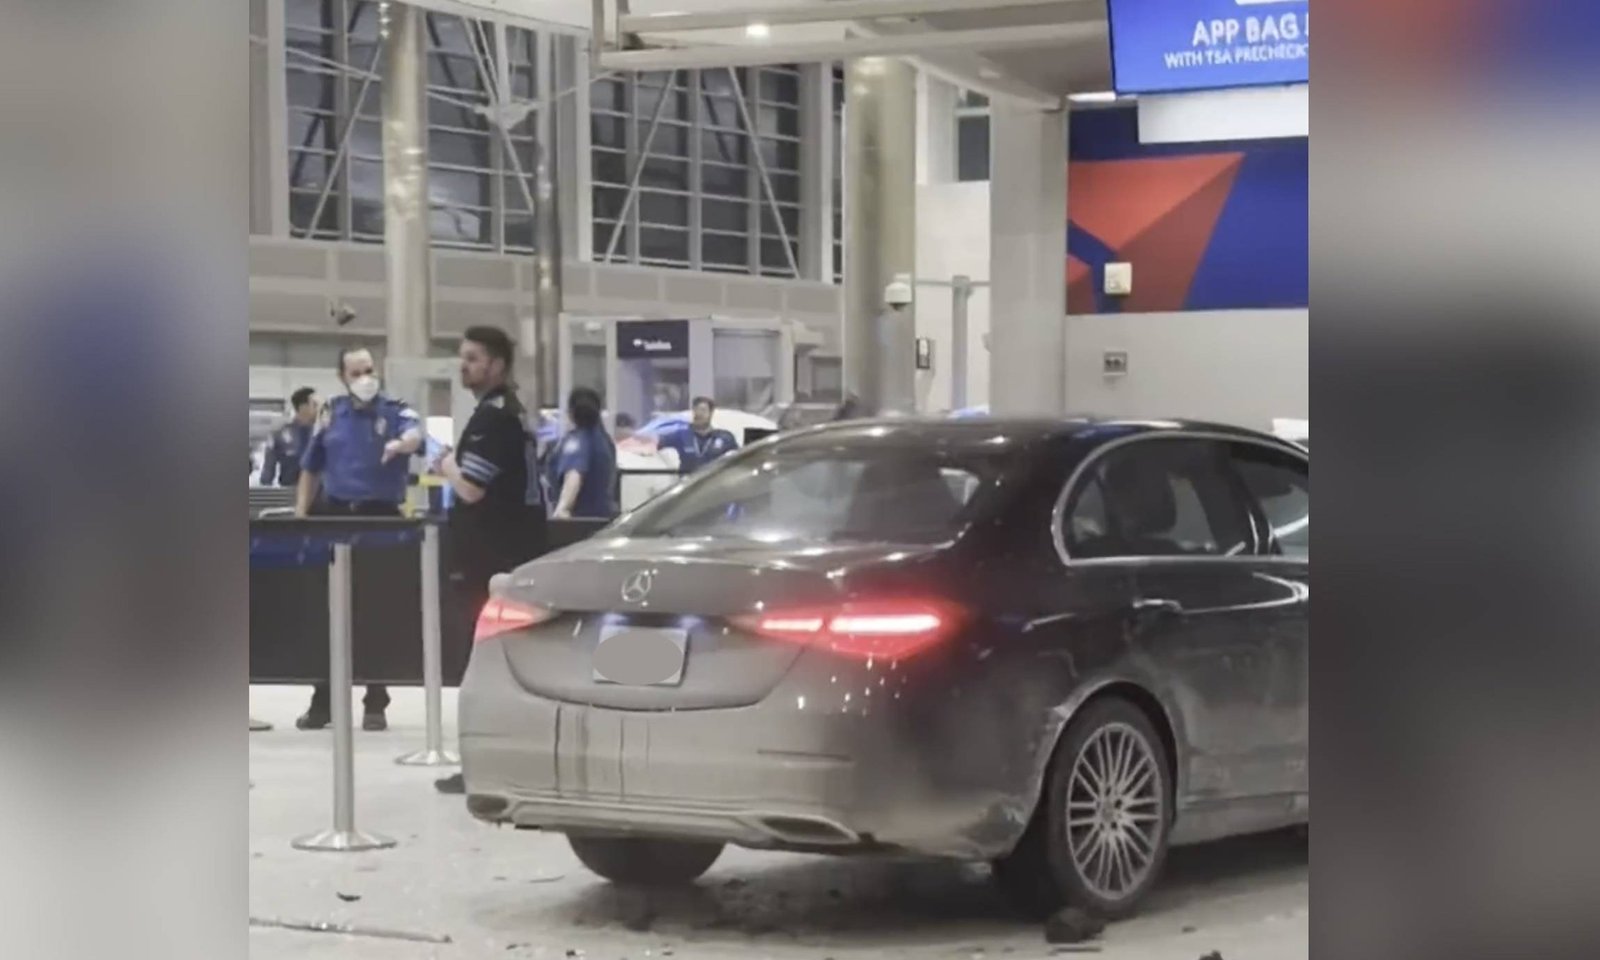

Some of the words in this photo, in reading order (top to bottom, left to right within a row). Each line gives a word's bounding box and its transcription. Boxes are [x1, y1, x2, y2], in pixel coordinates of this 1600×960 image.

[1193, 19, 1240, 46] APP
[1246, 13, 1299, 43] BAG
[1164, 51, 1203, 69] WITH
[1205, 48, 1232, 65] TSA
